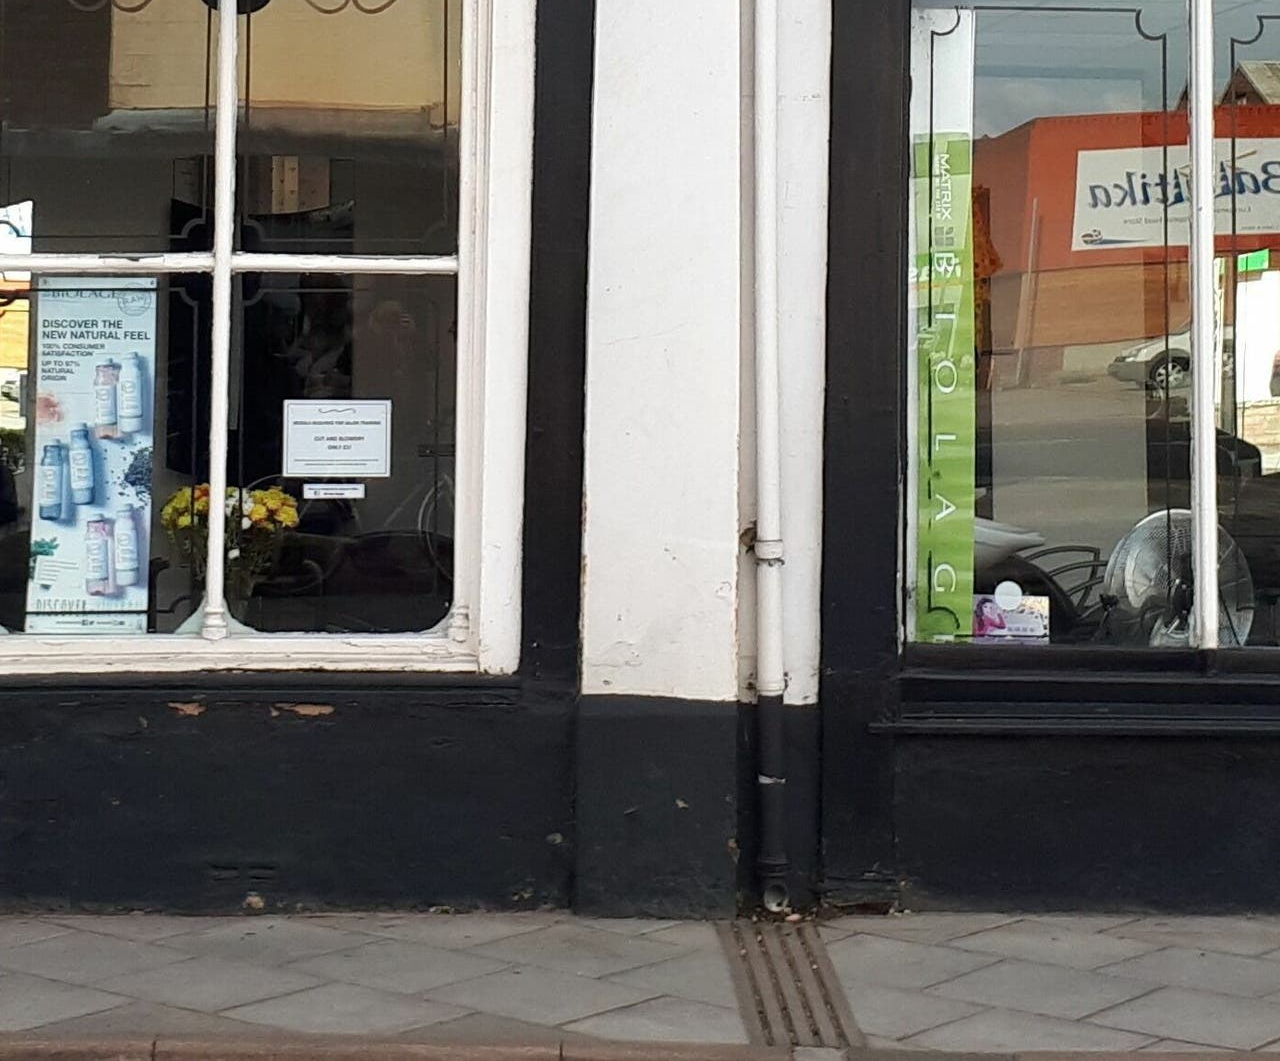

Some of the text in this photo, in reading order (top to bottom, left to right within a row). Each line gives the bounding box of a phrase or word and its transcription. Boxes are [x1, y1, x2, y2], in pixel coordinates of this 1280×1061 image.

[940, 153, 953, 220] MATRIX
[42, 319, 124, 329] DISCOVER THE
[42, 330, 151, 340] NEW NATURAL FEEL
